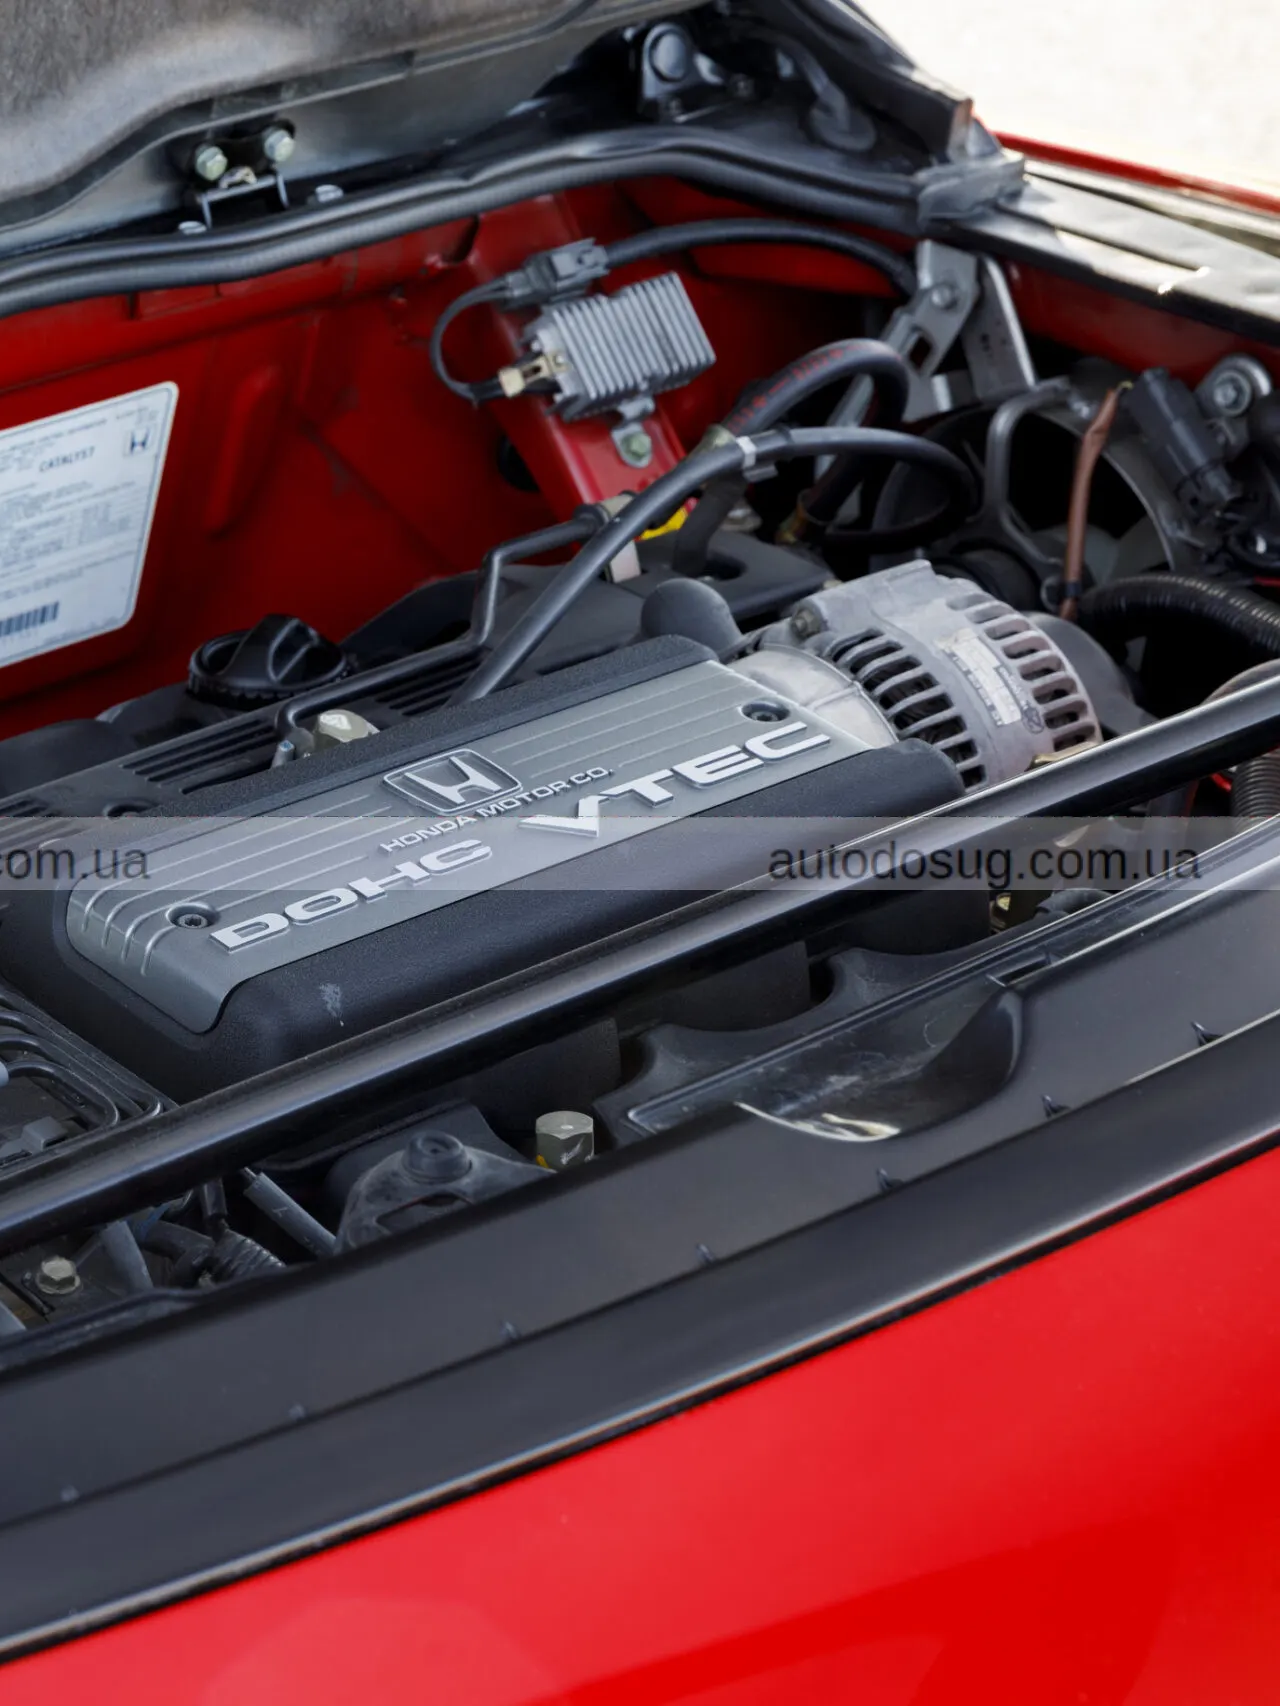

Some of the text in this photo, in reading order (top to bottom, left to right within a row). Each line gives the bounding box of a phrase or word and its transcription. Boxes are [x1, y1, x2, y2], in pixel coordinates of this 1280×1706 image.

[39, 446, 96, 472] CATALYST
[209, 721, 832, 953] DOHC VTEC
[380, 766, 615, 854] HONDA MOTOR CO.
